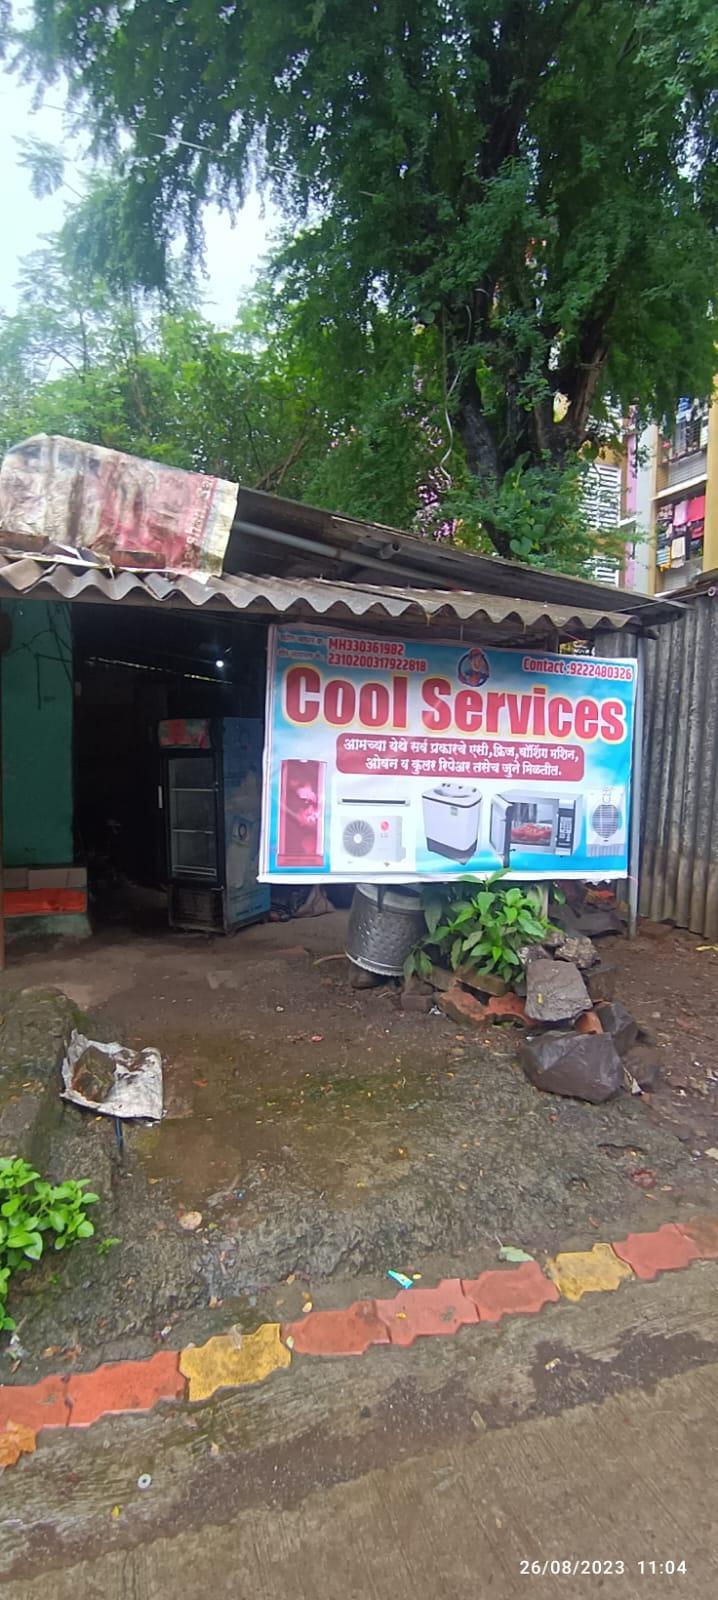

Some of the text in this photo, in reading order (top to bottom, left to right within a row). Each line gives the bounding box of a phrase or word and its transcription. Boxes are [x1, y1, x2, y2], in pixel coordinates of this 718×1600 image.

[328, 637, 405, 656] MH330361982
[523, 658, 565, 674] Contact
[285, 666, 624, 742] Cool Services
[343, 738, 387, 752] आमच्या
[389, 737, 408, 753] येथे
[410, 738, 428, 754] सर्व
[430, 740, 467, 755] प्रकारचे
[365, 754, 398, 770] ओवन
[411, 758, 436, 774] कुलर
[438, 757, 470, 774] रिपेअर
[472, 759, 500, 773] तसेच
[502, 760, 520, 777] जुने
